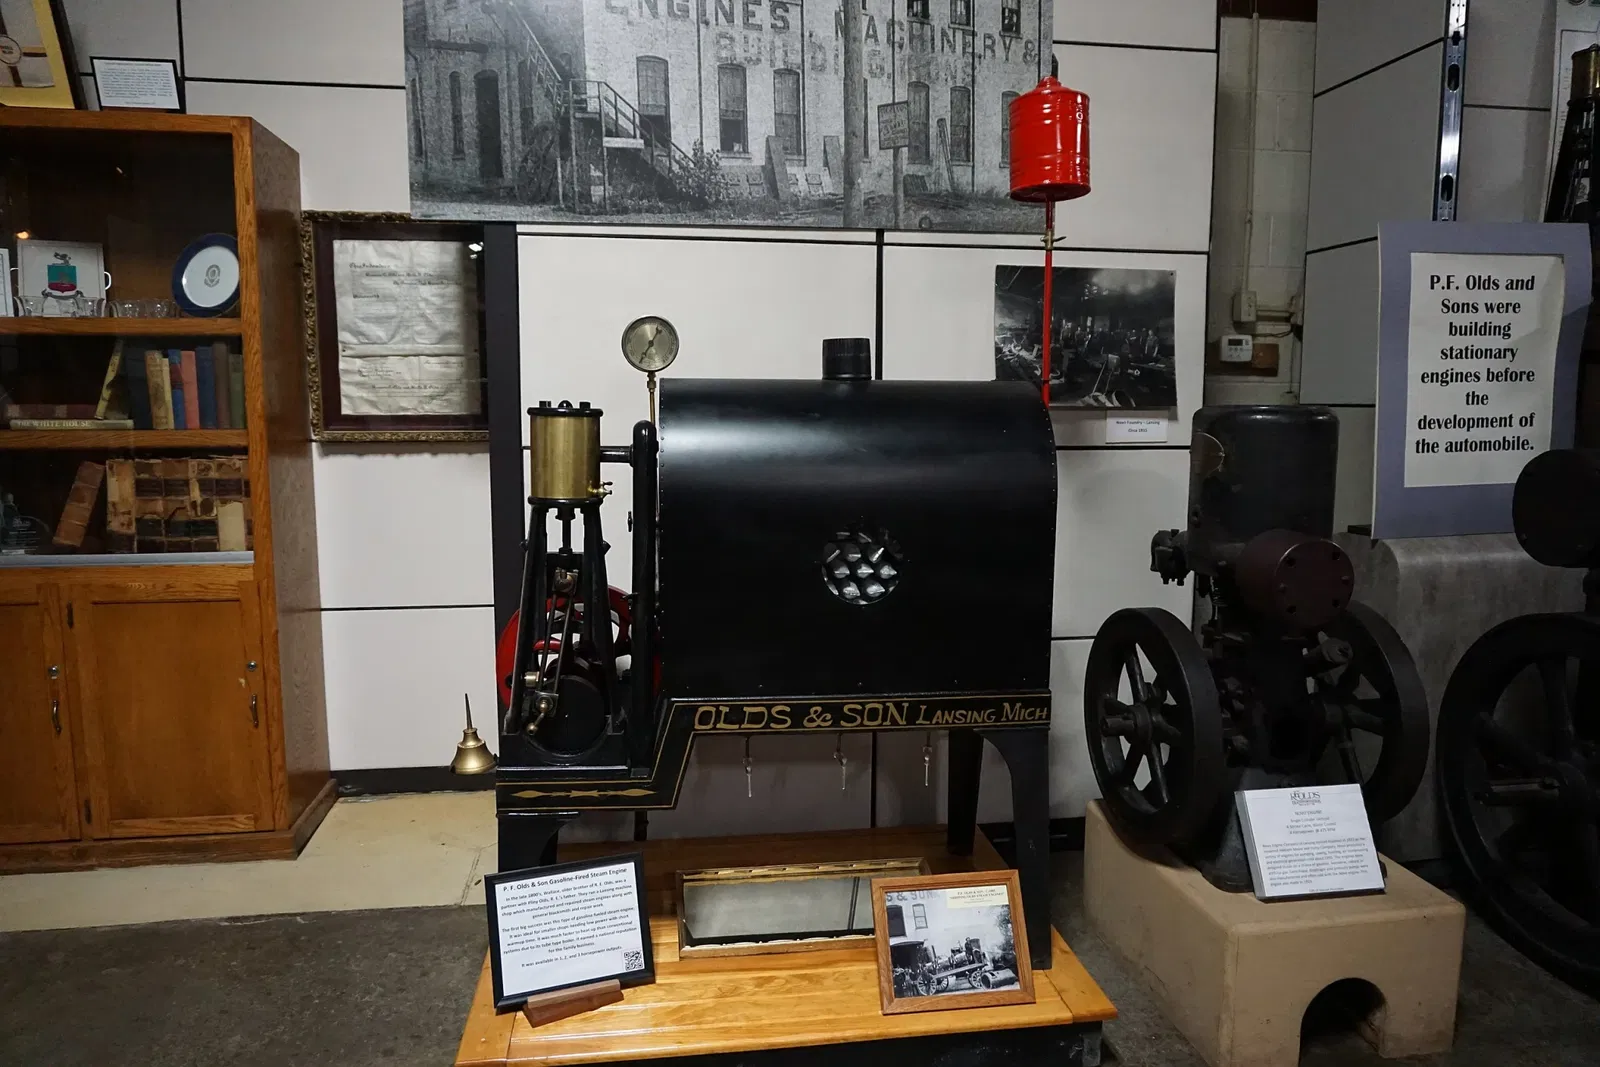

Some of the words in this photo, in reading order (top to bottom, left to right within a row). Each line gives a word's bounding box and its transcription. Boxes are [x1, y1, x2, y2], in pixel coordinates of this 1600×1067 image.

[1430, 275, 1459, 290] P.F.
[1465, 275, 1500, 290] Olds
[1505, 275, 1535, 290] and
[1441, 298, 1479, 314] Sons
[1484, 302, 1521, 314] were
[1449, 322, 1512, 340] building
[1440, 345, 1519, 362] stationary
[1421, 368, 1481, 387] engines
[1486, 367, 1535, 383] before
[1465, 391, 1489, 406] the
[1417, 414, 1514, 432] development
[1519, 412, 1536, 428] of
[1415, 439, 1440, 454] the
[1444, 436, 1535, 453] automobile.
[694, 705, 792, 730] OLDS
[803, 705, 833, 727] &
[840, 702, 909, 728] SON
[548, 874, 589, 884] Gasoline-Fired
[897, 892, 908, 901] &
[580, 948, 605, 957] horsepower
